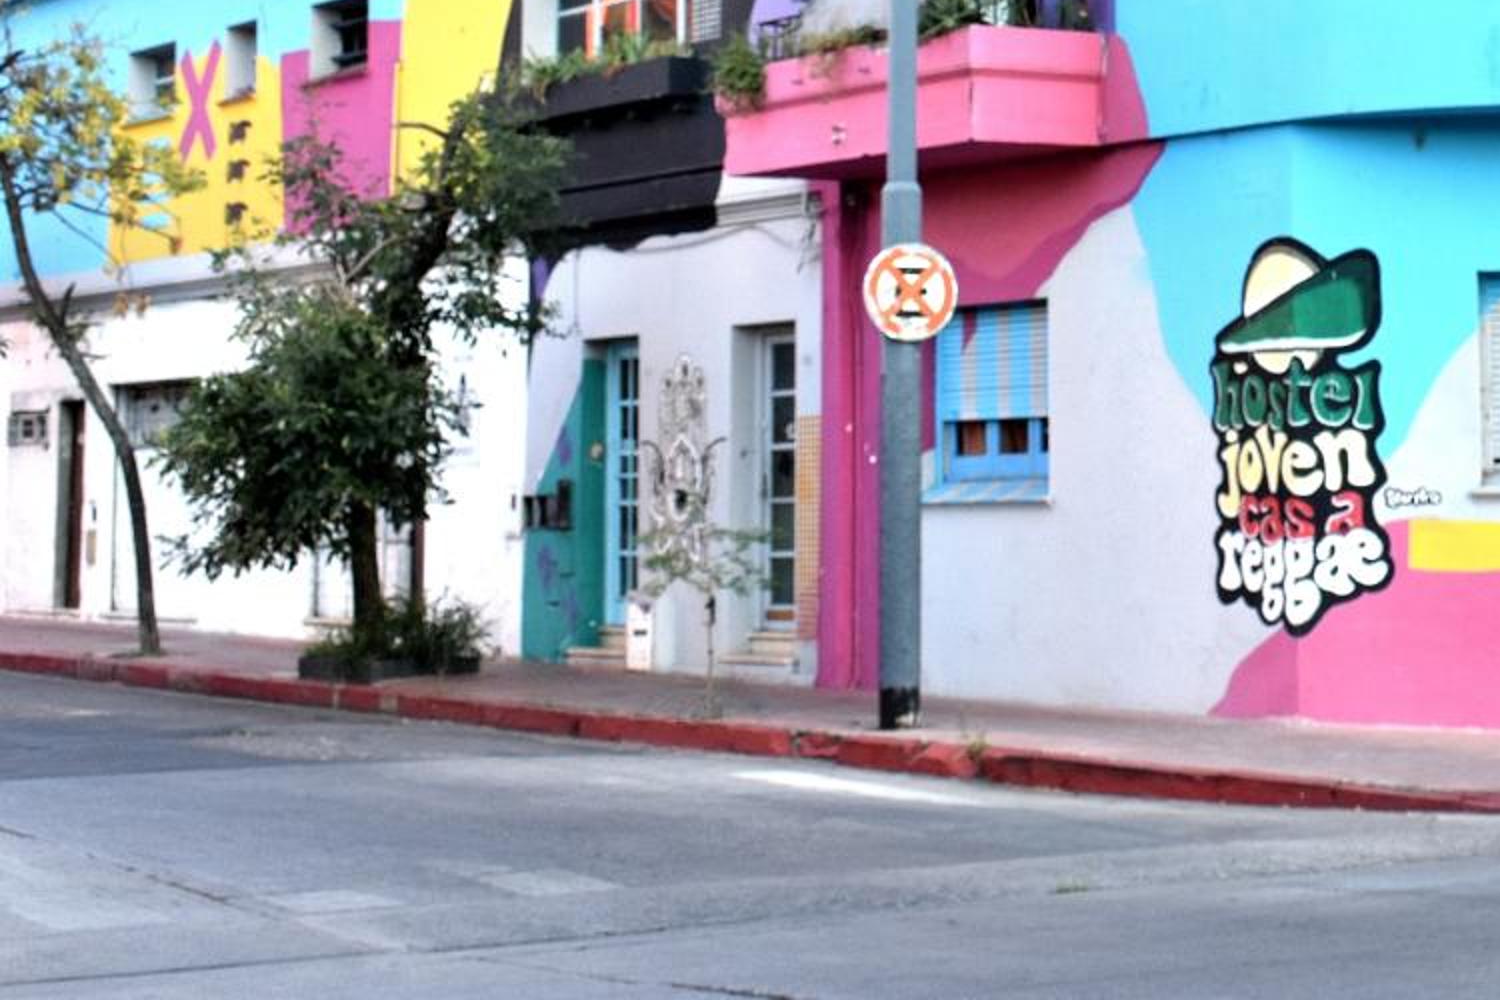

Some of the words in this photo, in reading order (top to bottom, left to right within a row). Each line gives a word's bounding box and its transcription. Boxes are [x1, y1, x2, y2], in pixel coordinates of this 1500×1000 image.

[1212, 355, 1376, 431] hostel
[1217, 428, 1377, 518] joven
[1217, 528, 1389, 627] reggae
